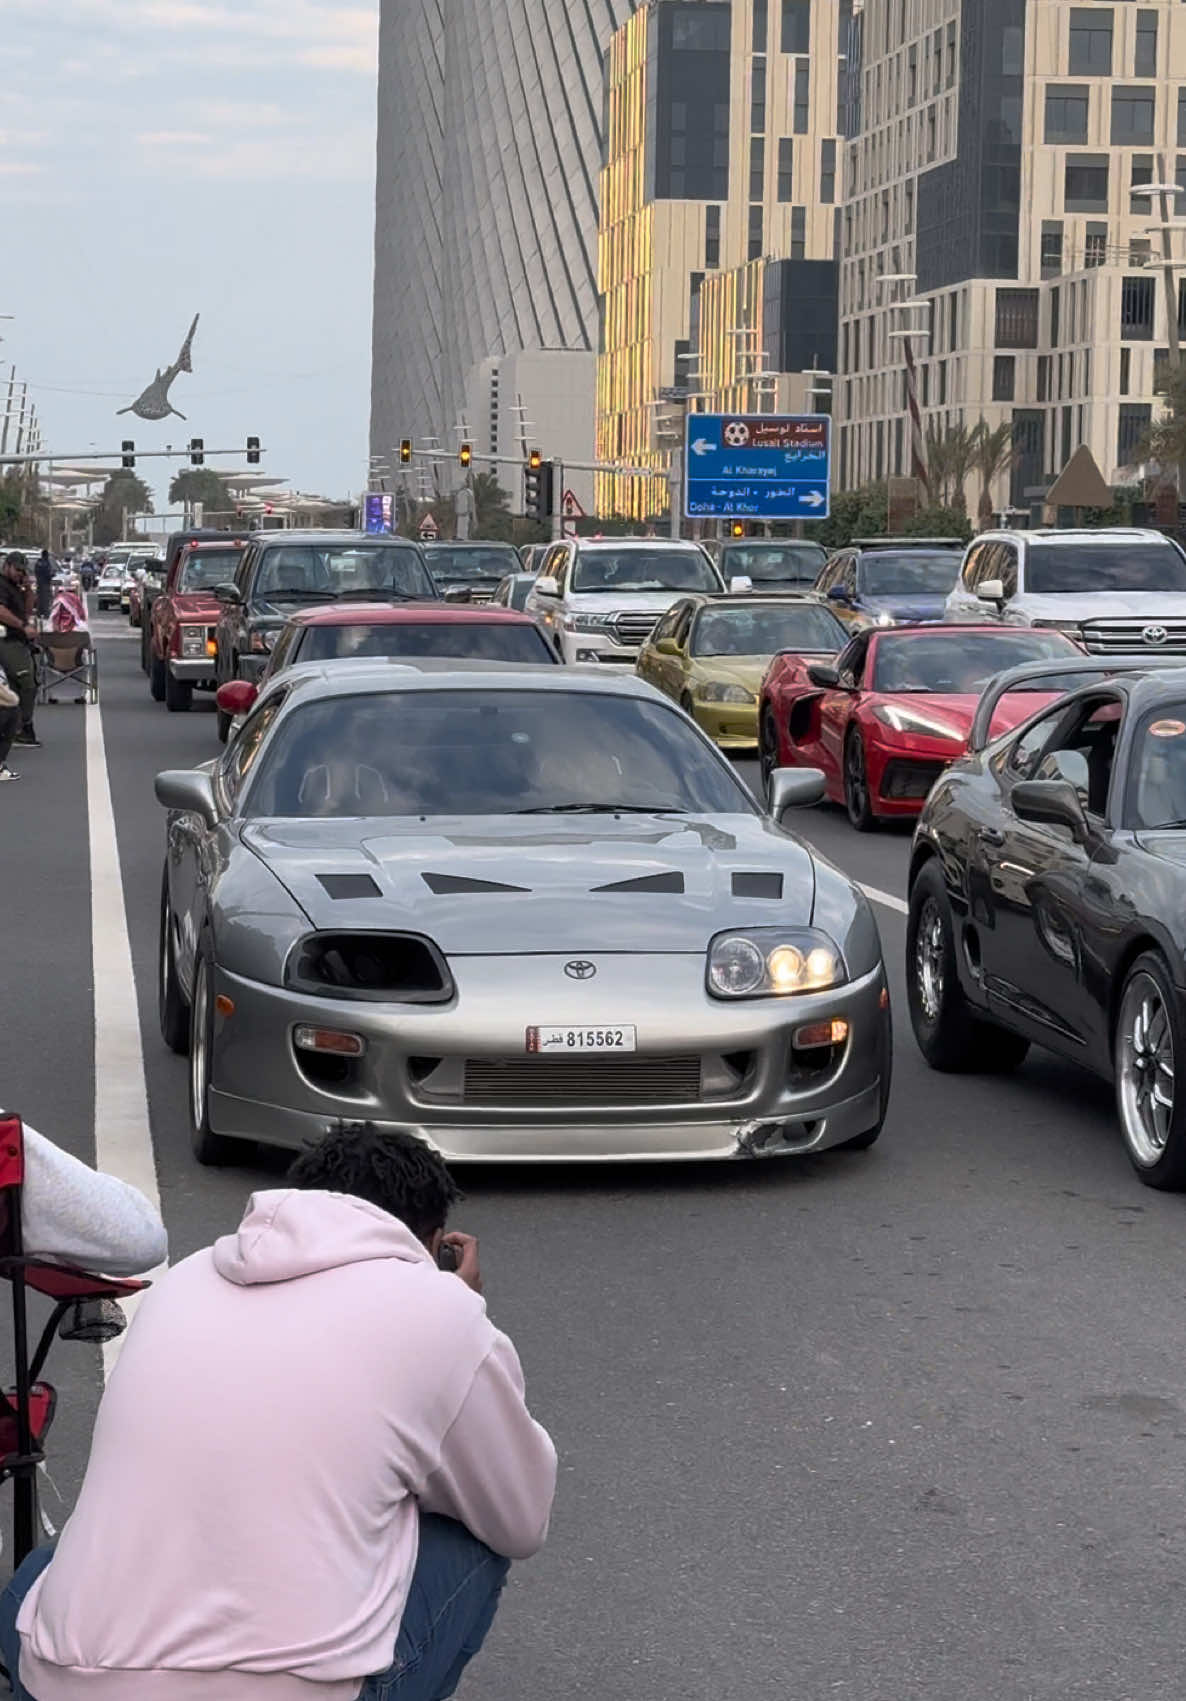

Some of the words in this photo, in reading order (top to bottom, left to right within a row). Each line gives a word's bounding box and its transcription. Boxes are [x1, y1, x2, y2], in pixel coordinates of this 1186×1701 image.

[752, 438, 780, 448] Lusail
[783, 439, 824, 448] Stadium
[689, 502, 715, 511] Doha
[736, 502, 760, 512] Khor
[542, 1032, 563, 1047] قطر
[566, 1031, 624, 1047] 815562
